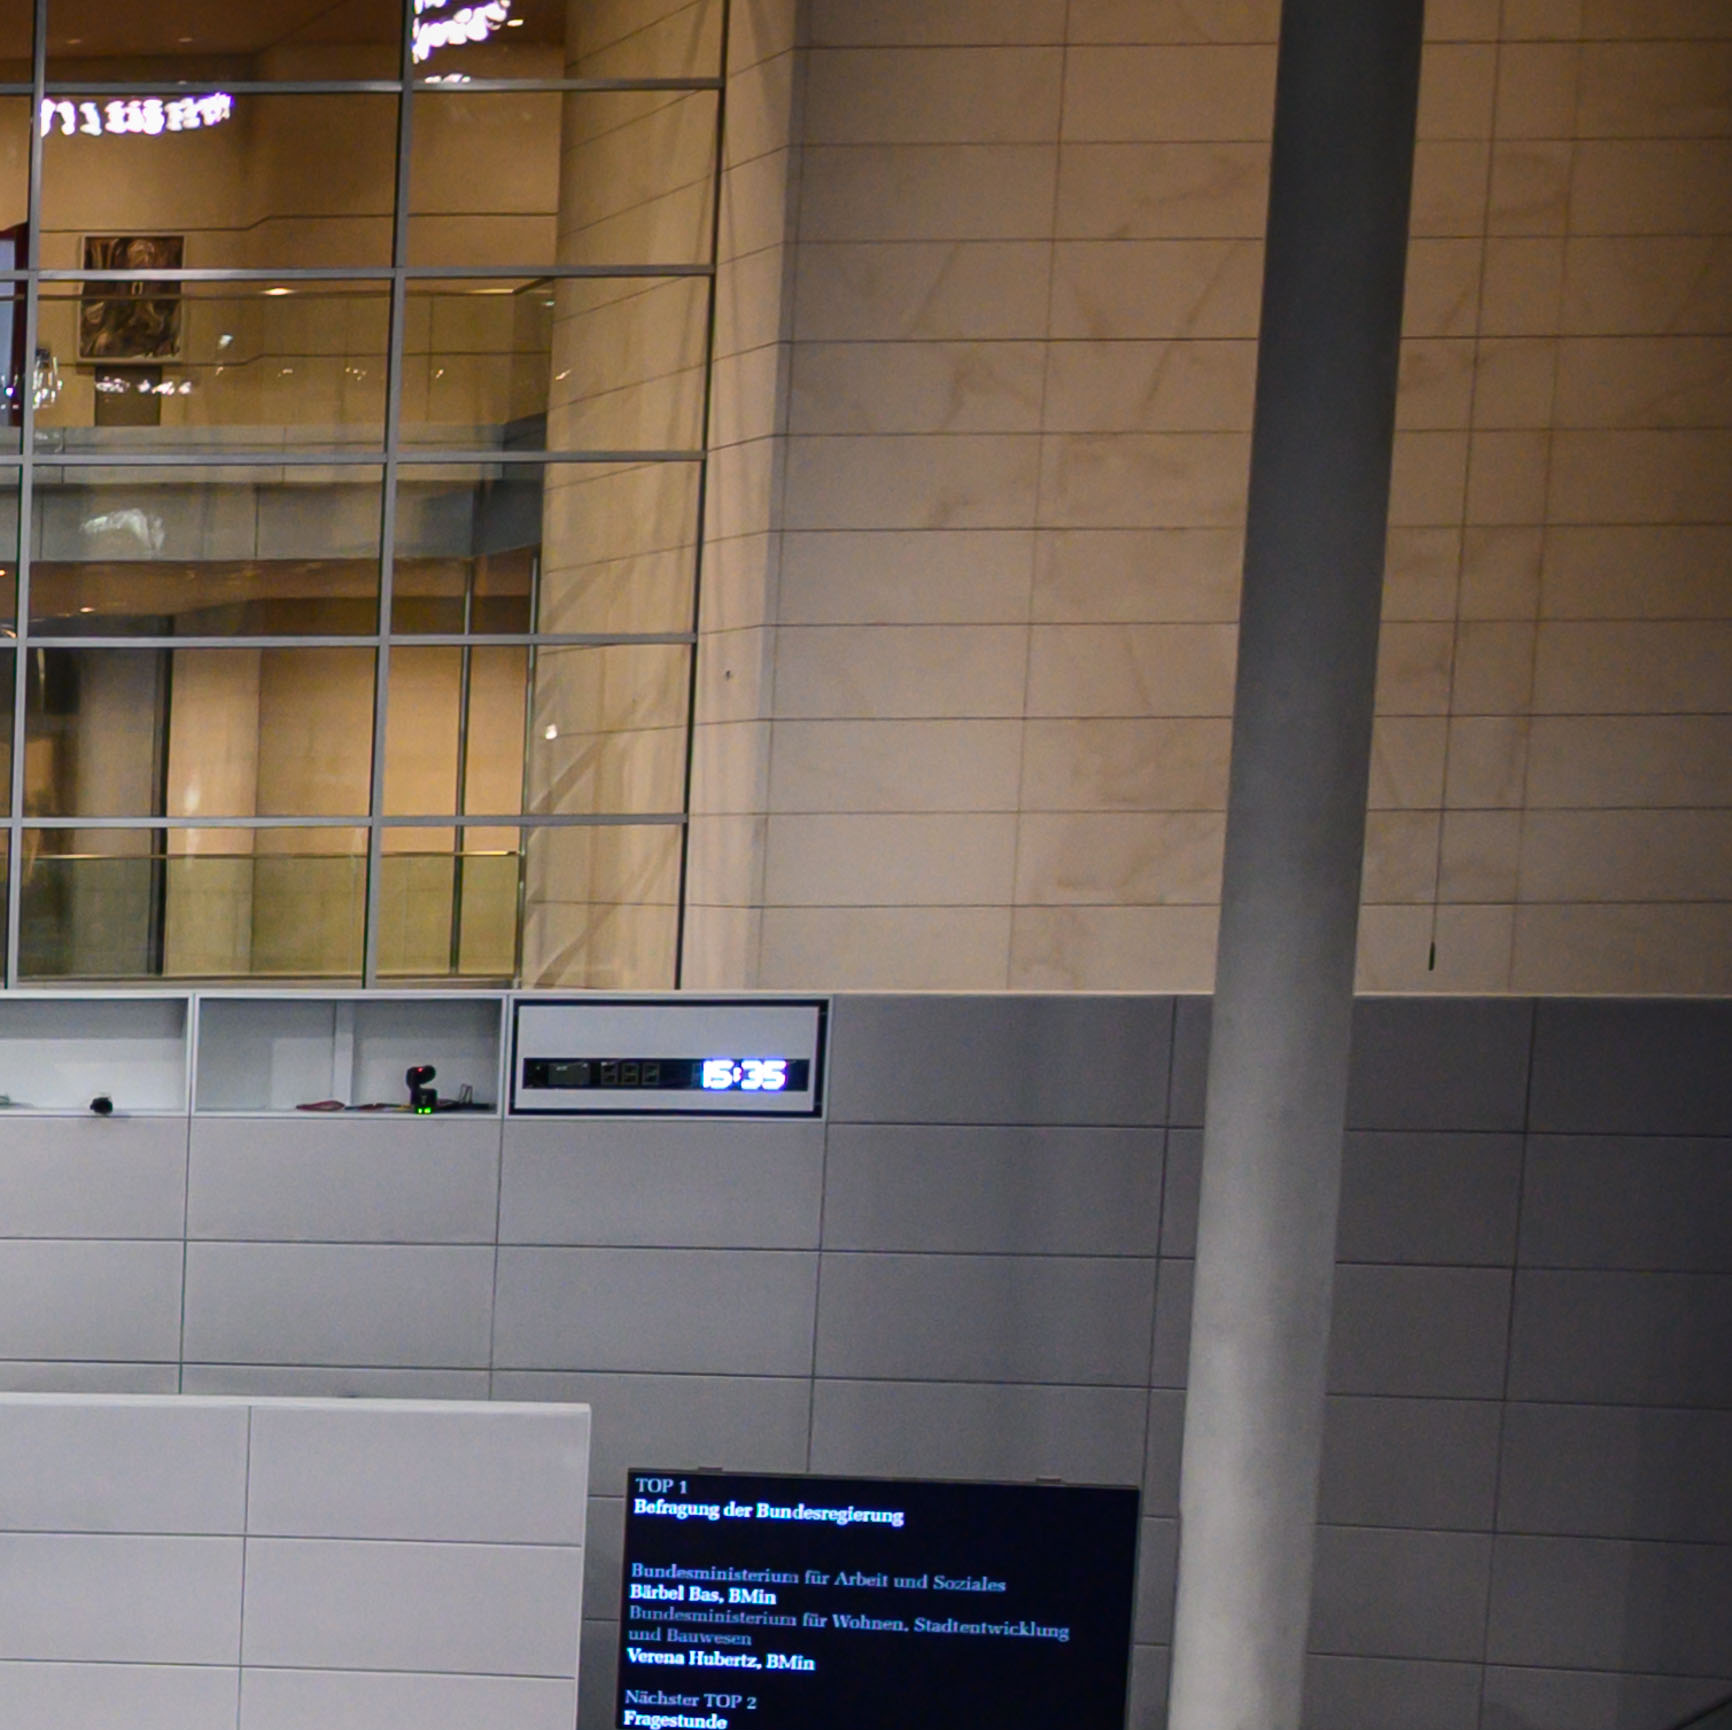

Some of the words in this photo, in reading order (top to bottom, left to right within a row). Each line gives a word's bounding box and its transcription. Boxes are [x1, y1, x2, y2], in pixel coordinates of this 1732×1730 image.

[635, 1477, 675, 1493] TOP
[679, 1479, 688, 1494] 1
[634, 1499, 720, 1520] Befragung
[723, 1500, 753, 1518] der
[756, 1503, 904, 1527] Bundesregierung
[631, 1562, 799, 1584] Bundesministerium
[804, 1569, 829, 1585] für
[834, 1570, 888, 1588] Arbeit
[893, 1572, 928, 1590] und
[933, 1575, 1007, 1593] Soziales
[630, 1584, 685, 1602] Bärbel
[688, 1586, 724, 1604] Bas,
[728, 1587, 777, 1605] BMin
[629, 1604, 797, 1627] Bundesministerium
[802, 1611, 827, 1628] für
[914, 1616, 1070, 1642] Stadtentwicklung
[628, 1625, 662, 1643] und
[666, 1627, 752, 1646] Bauwesen
[627, 1647, 685, 1666] Verena
[688, 1650, 762, 1671] Hubertz,
[766, 1654, 815, 1671] BMin
[625, 1689, 699, 1709] Nächster
[703, 1692, 743, 1710] TOP
[746, 1696, 757, 1710] 2
[624, 1710, 728, 1730] Fragestunde
